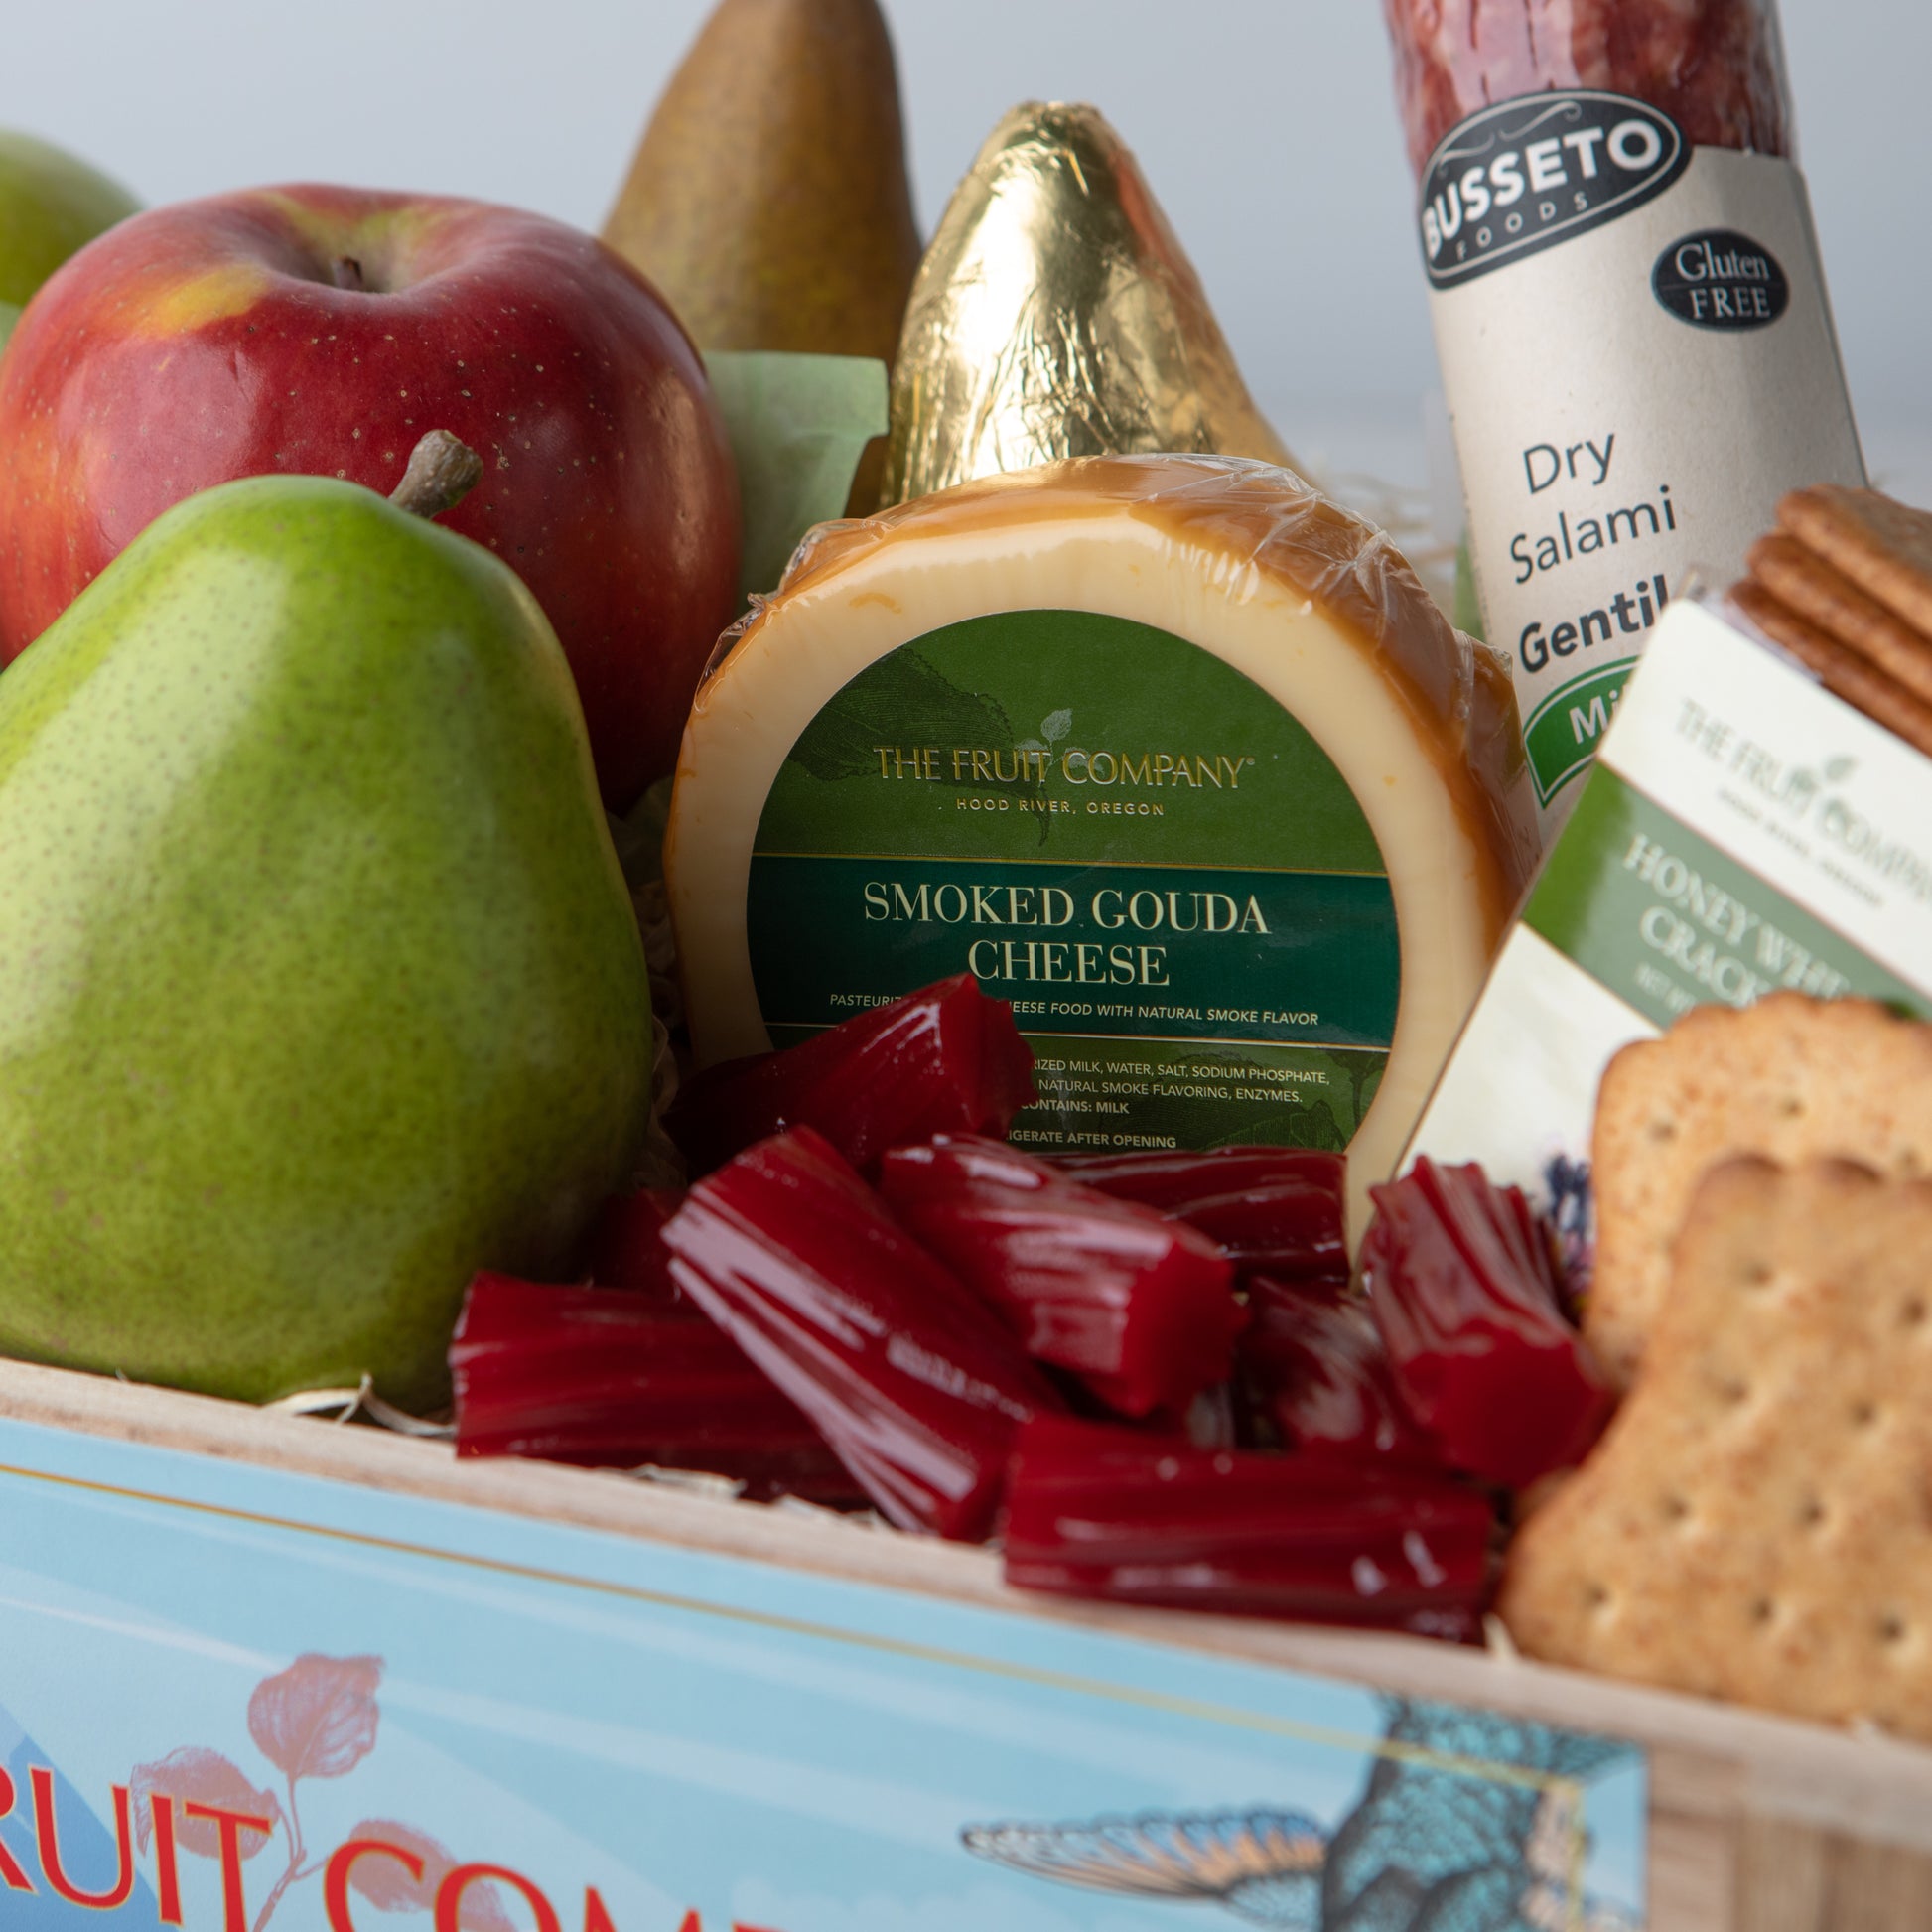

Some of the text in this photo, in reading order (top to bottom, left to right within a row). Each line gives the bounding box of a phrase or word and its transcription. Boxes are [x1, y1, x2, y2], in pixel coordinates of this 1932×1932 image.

[1423, 119, 1662, 260] BUSSETO
[1456, 192, 1588, 261] FOODS
[1675, 240, 1770, 281] Gluten
[1690, 286, 1771, 319] FREE
[1524, 433, 1615, 494] Dry
[1510, 485, 1676, 584] Salami
[873, 747, 942, 780] THE
[952, 749, 1052, 782] FRUIT
[956, 798, 1165, 816] HOOD RIVER, OREGON
[864, 882, 1273, 934] SMOKED GOUDA
[1623, 832, 1761, 947] HONEY
[968, 940, 1170, 986] CHEESE
[1050, 1003, 1092, 1015] FOOD
[1097, 1004, 1133, 1017] WITH
[1138, 1006, 1202, 1020] NATURAL
[1206, 1009, 1258, 1023] SMOKE
[1263, 1011, 1318, 1025] FLAVOR
[1038, 1079, 1303, 1103] NATURAL SMOKE FLAVORING, ENZYMES.
[1069, 1060, 1103, 1074] MILK,
[1106, 1063, 1154, 1077] WATER,
[1158, 1064, 1189, 1078] SALT,
[1192, 1066, 1245, 1079] SODIUM
[1249, 1069, 1330, 1085] PHOSPHATE,
[1096, 1102, 1130, 1114] MILK
[1067, 1133, 1109, 1146] AFTER
[1113, 1136, 1176, 1148] OPENING
